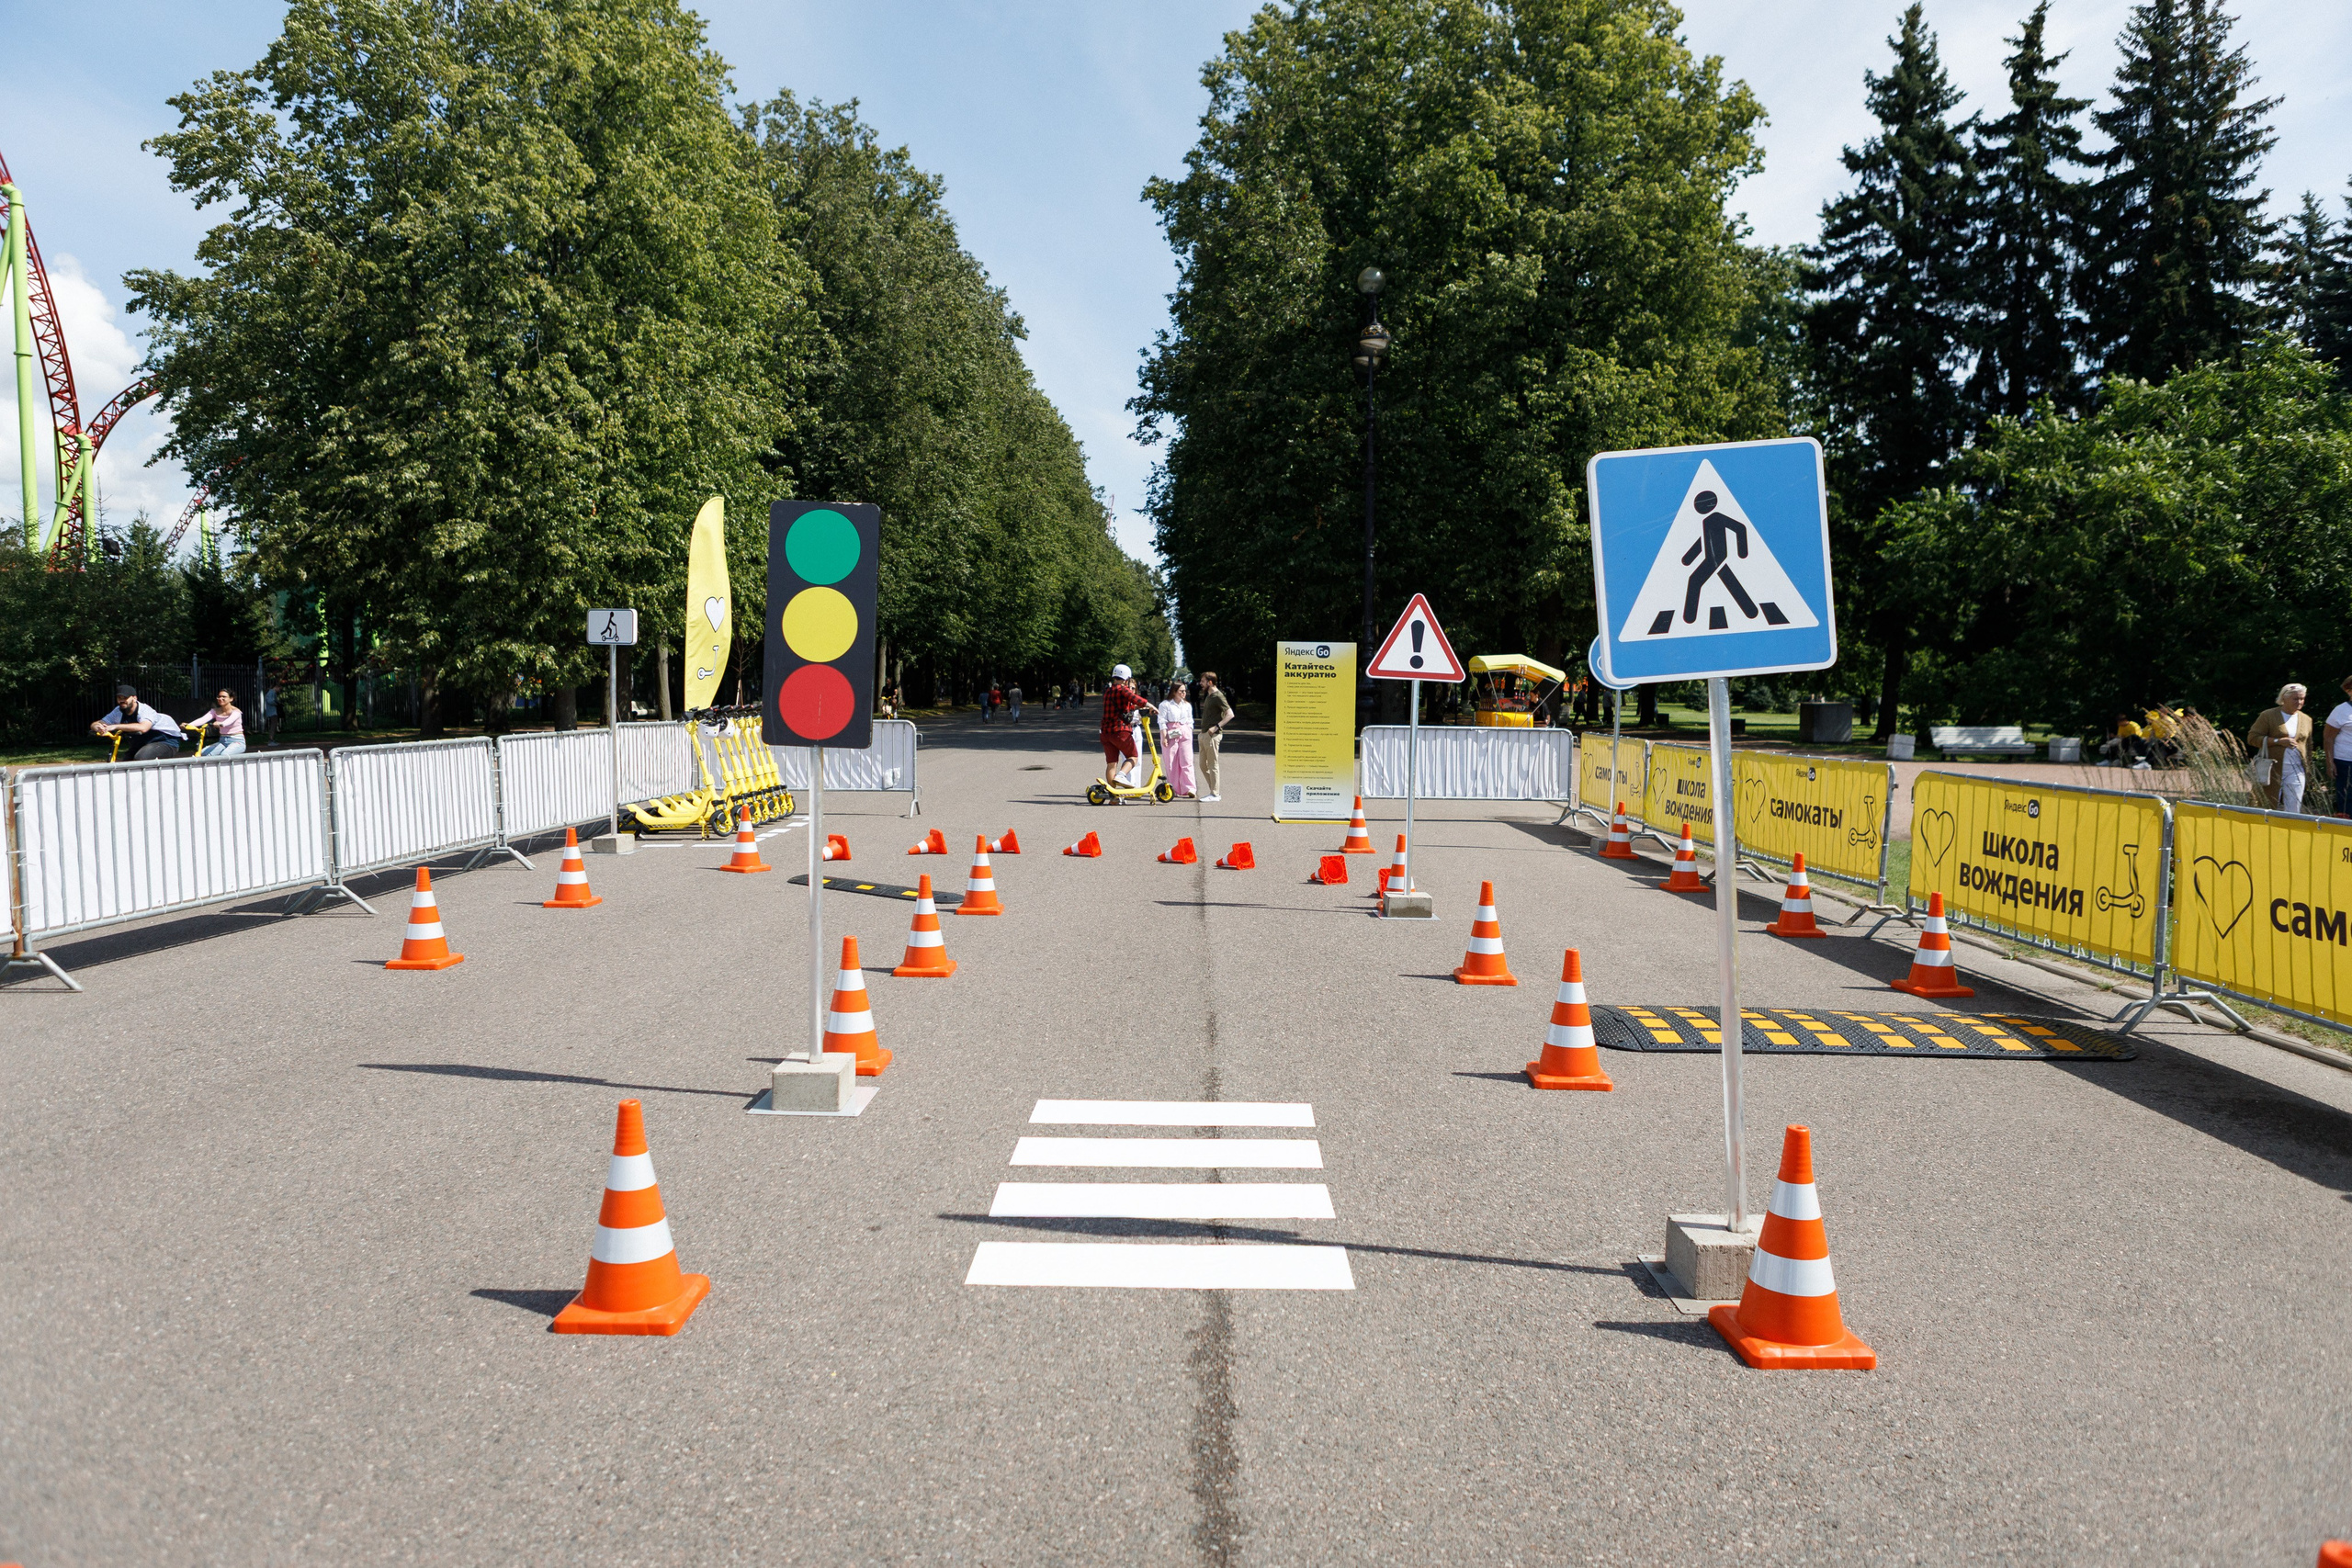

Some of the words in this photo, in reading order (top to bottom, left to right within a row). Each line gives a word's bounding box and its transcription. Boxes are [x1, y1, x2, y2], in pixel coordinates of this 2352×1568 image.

[1284, 647, 1314, 657] Яндекс
[1317, 647, 1329, 657] Go
[1284, 662, 1335, 671] Катайтесь
[1595, 765, 1627, 784] самоты
[1677, 778, 1706, 799] школа
[1665, 799, 1713, 825] вождения
[1770, 797, 1842, 829] самокаты
[2004, 799, 2027, 814] Яндекс
[2028, 800, 2039, 816] Go
[1982, 830, 2059, 872] школа
[1959, 862, 2084, 917] вождения
[2270, 897, 2352, 947] сам
